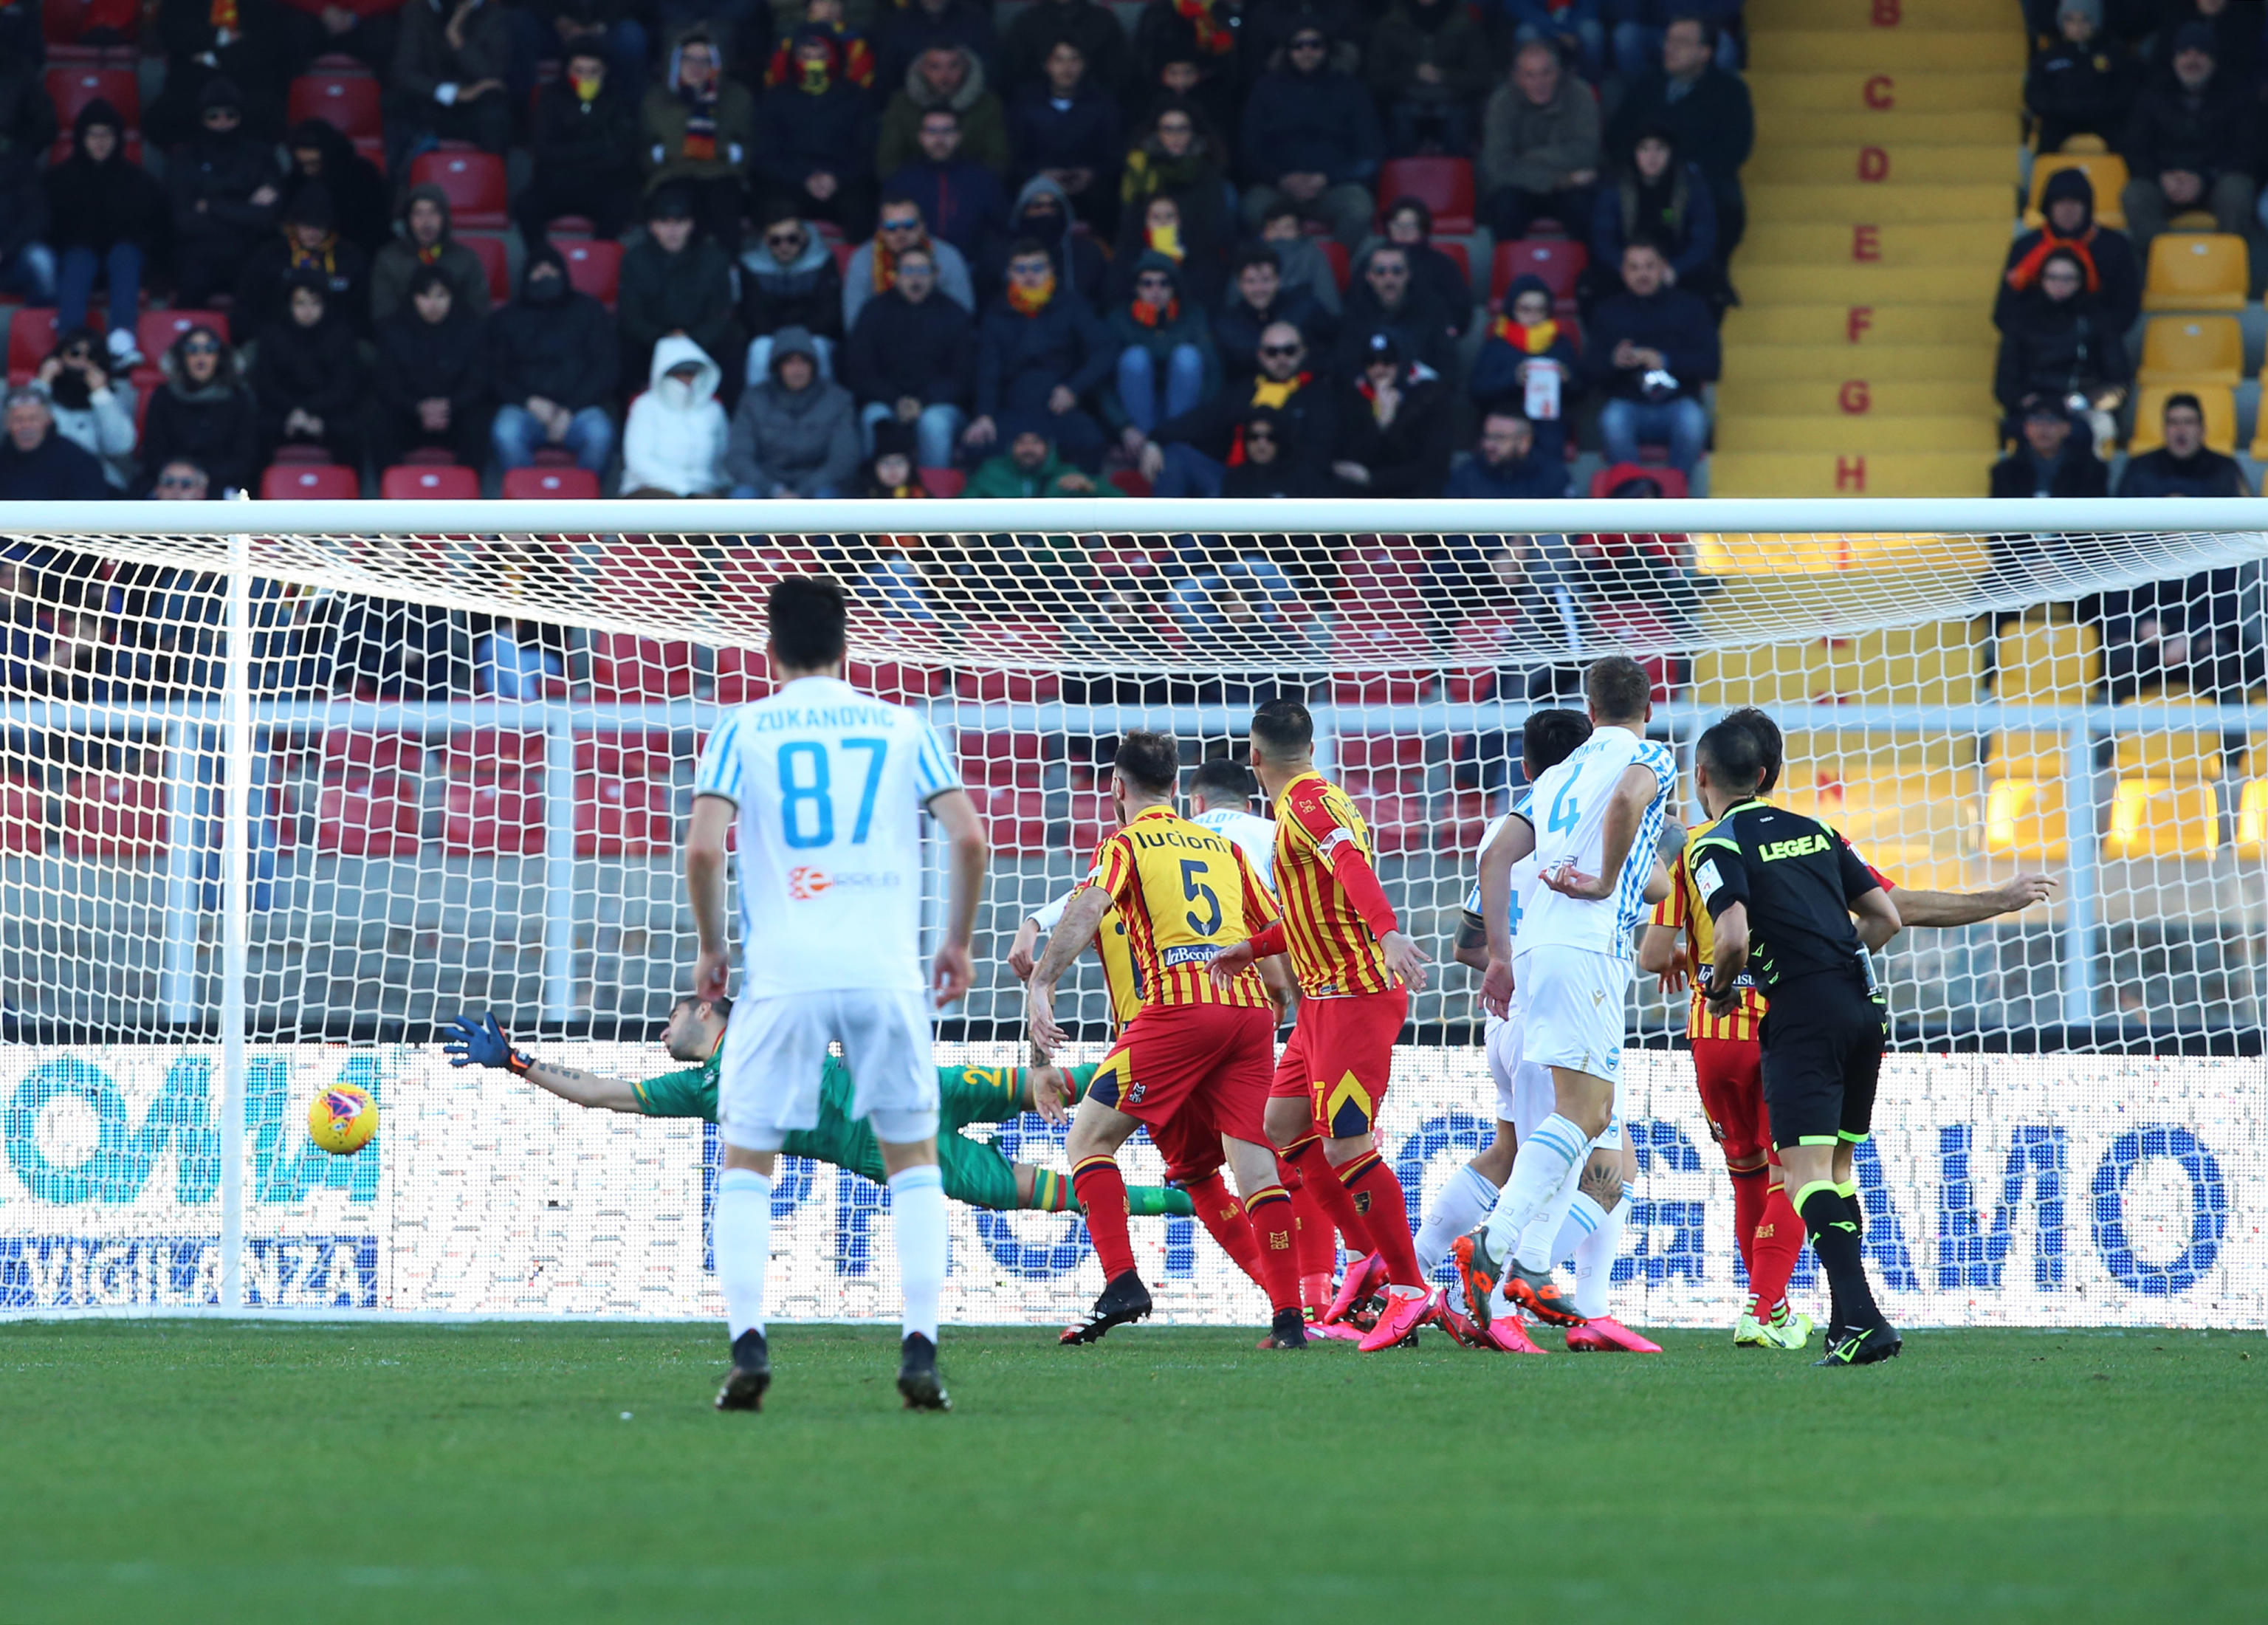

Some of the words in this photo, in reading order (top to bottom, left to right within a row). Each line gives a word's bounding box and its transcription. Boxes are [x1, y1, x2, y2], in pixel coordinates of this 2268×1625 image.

[1871, 0, 1901, 28] B
[1863, 76, 1894, 110] C
[1857, 148, 1889, 182] D
[1852, 225, 1880, 262] E
[1846, 307, 1872, 344] F
[1838, 380, 1871, 415] G
[1835, 456, 1866, 492] H
[777, 738, 887, 848] 87
[1547, 763, 1584, 839] 4
[1135, 831, 1227, 853] lucioni
[1758, 834, 1832, 862] LEGEA
[1180, 859, 1222, 936] 5
